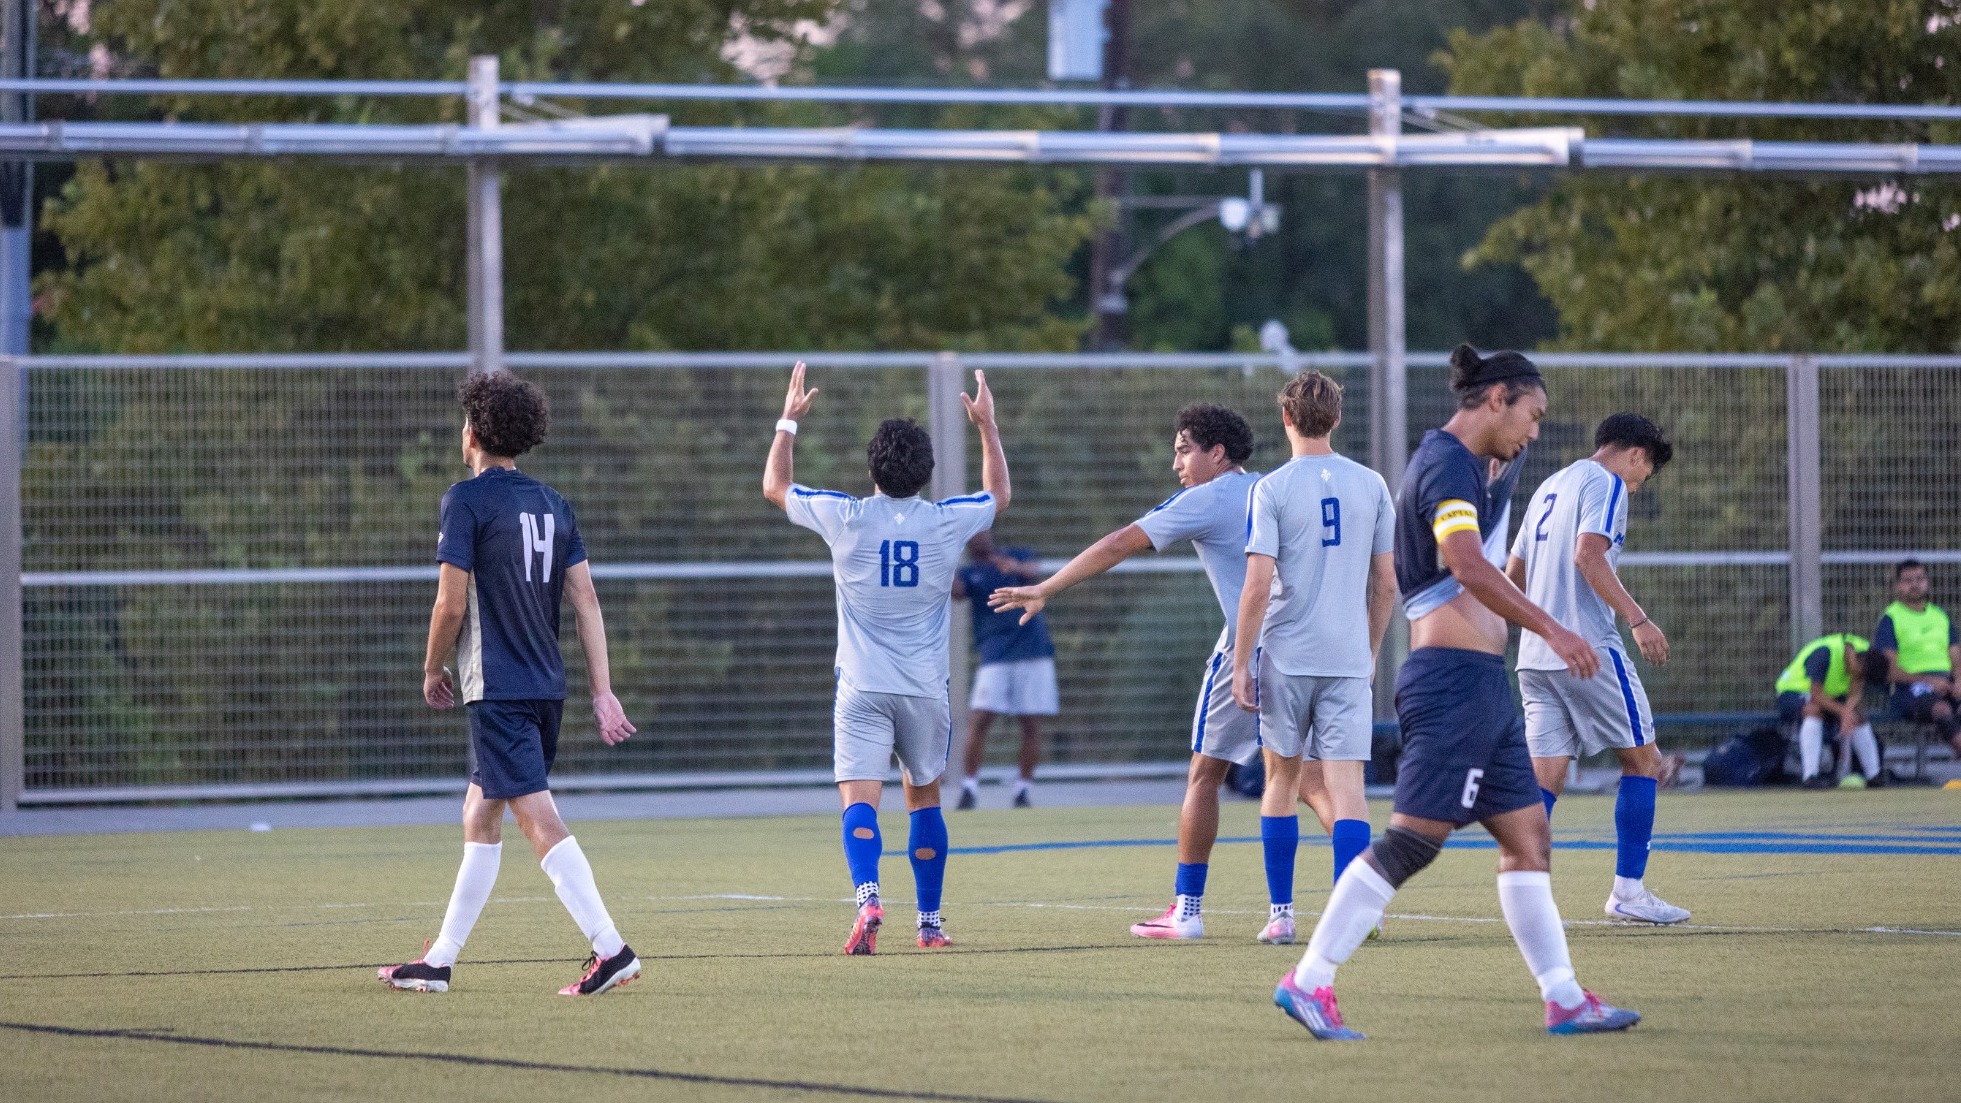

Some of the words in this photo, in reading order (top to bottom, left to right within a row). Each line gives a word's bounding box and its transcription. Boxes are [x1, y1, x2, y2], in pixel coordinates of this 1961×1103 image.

[1320, 497, 1341, 548] 9
[1535, 493, 1557, 542] 2
[519, 511, 555, 583] 14
[878, 539, 920, 587] 18
[1460, 768, 1484, 809] 6
